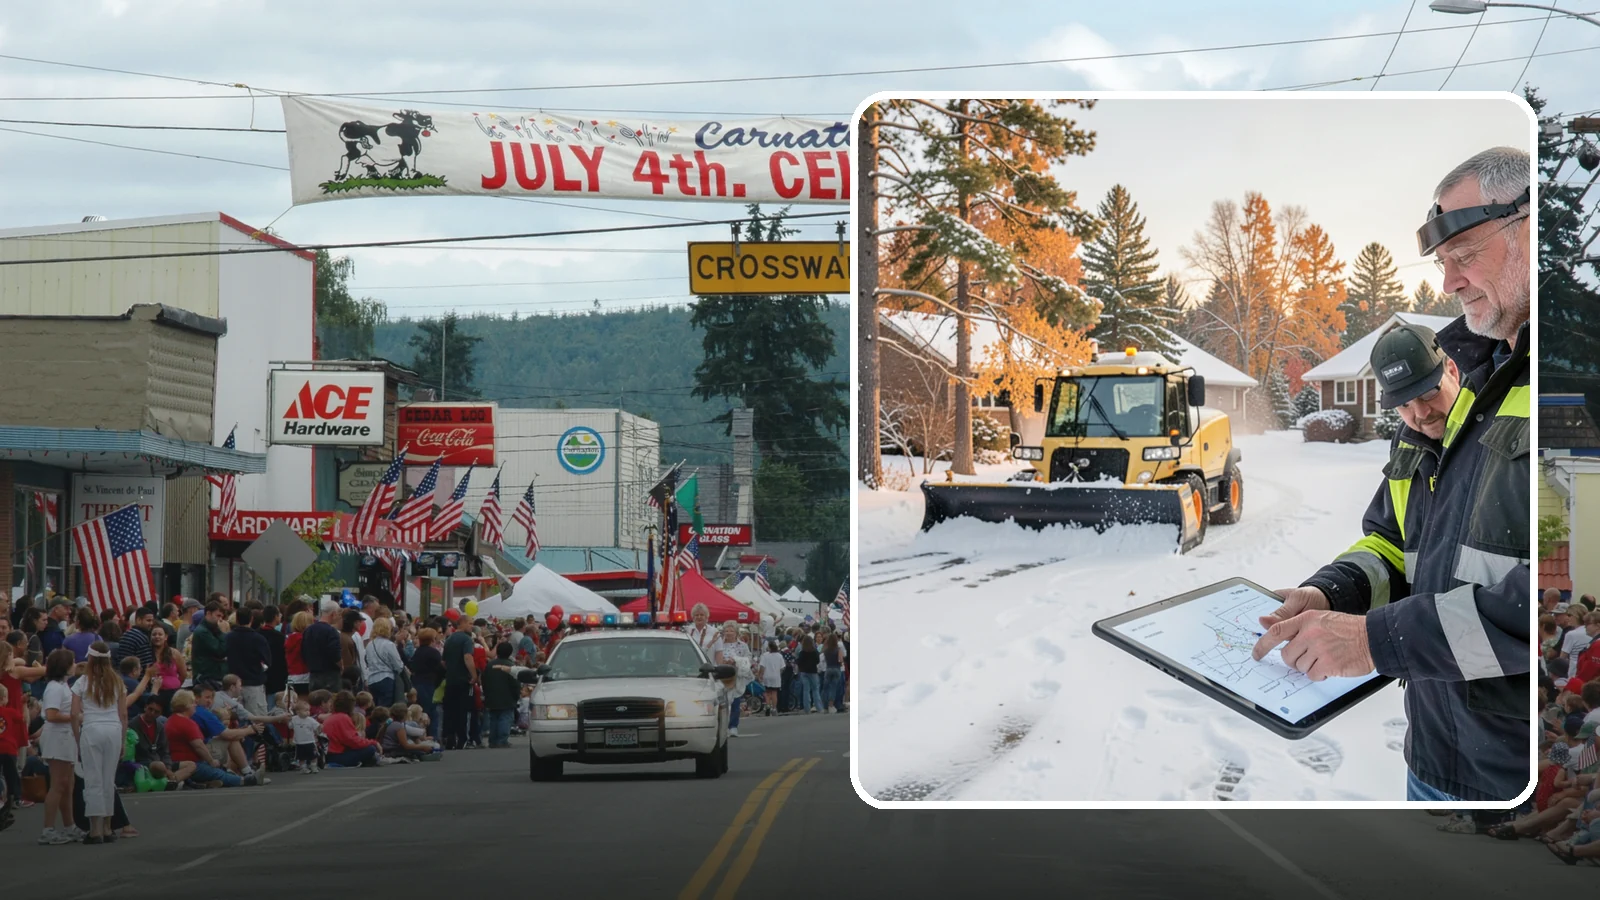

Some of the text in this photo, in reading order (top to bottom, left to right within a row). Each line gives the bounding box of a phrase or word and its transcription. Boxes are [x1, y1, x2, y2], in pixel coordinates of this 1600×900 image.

[481, 141, 604, 191] JULY
[632, 150, 747, 197] 4th.
[697, 254, 850, 280] CROSSWA
[282, 380, 373, 420] ACE
[406, 409, 453, 422] CEDAR
[283, 421, 371, 436] Hardware
[416, 428, 477, 447] Coca-Cola
[354, 466, 388, 482] Simpl
[95, 485, 124, 495] Vincent
[126, 486, 136, 495] de
[138, 486, 155, 496] Paul
[81, 503, 154, 522] THT
[688, 526, 741, 535] CRNATION
[699, 535, 731, 543] GLASS
